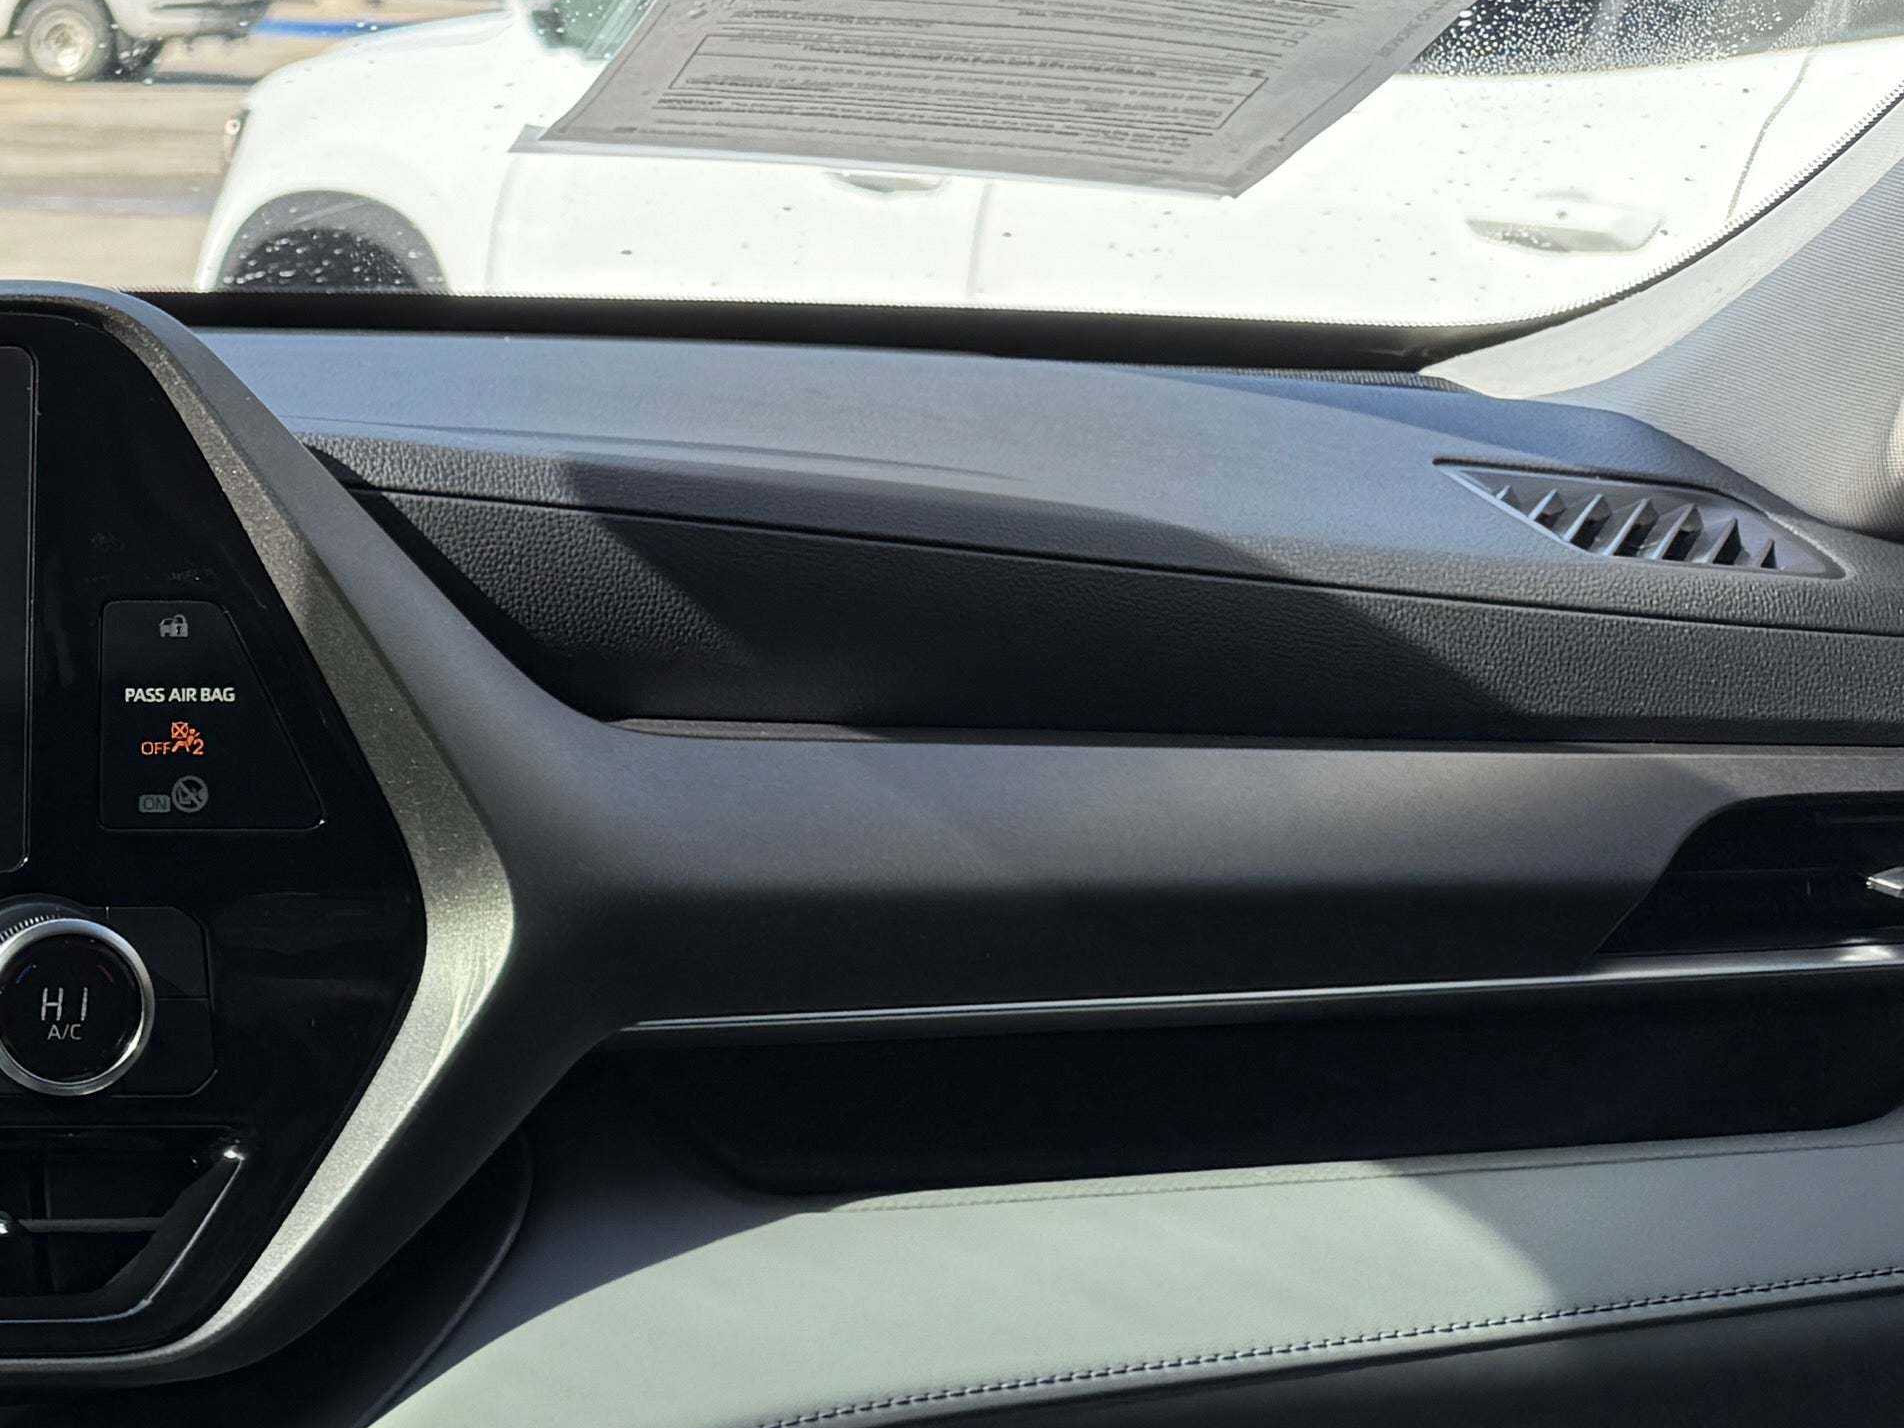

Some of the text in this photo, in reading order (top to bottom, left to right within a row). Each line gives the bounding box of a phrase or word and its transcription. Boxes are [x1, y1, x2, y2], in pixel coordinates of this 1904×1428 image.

[125, 687, 236, 702] PASS AIR BAG
[141, 741, 172, 755] OFF
[47, 1023, 82, 1041] A/C
